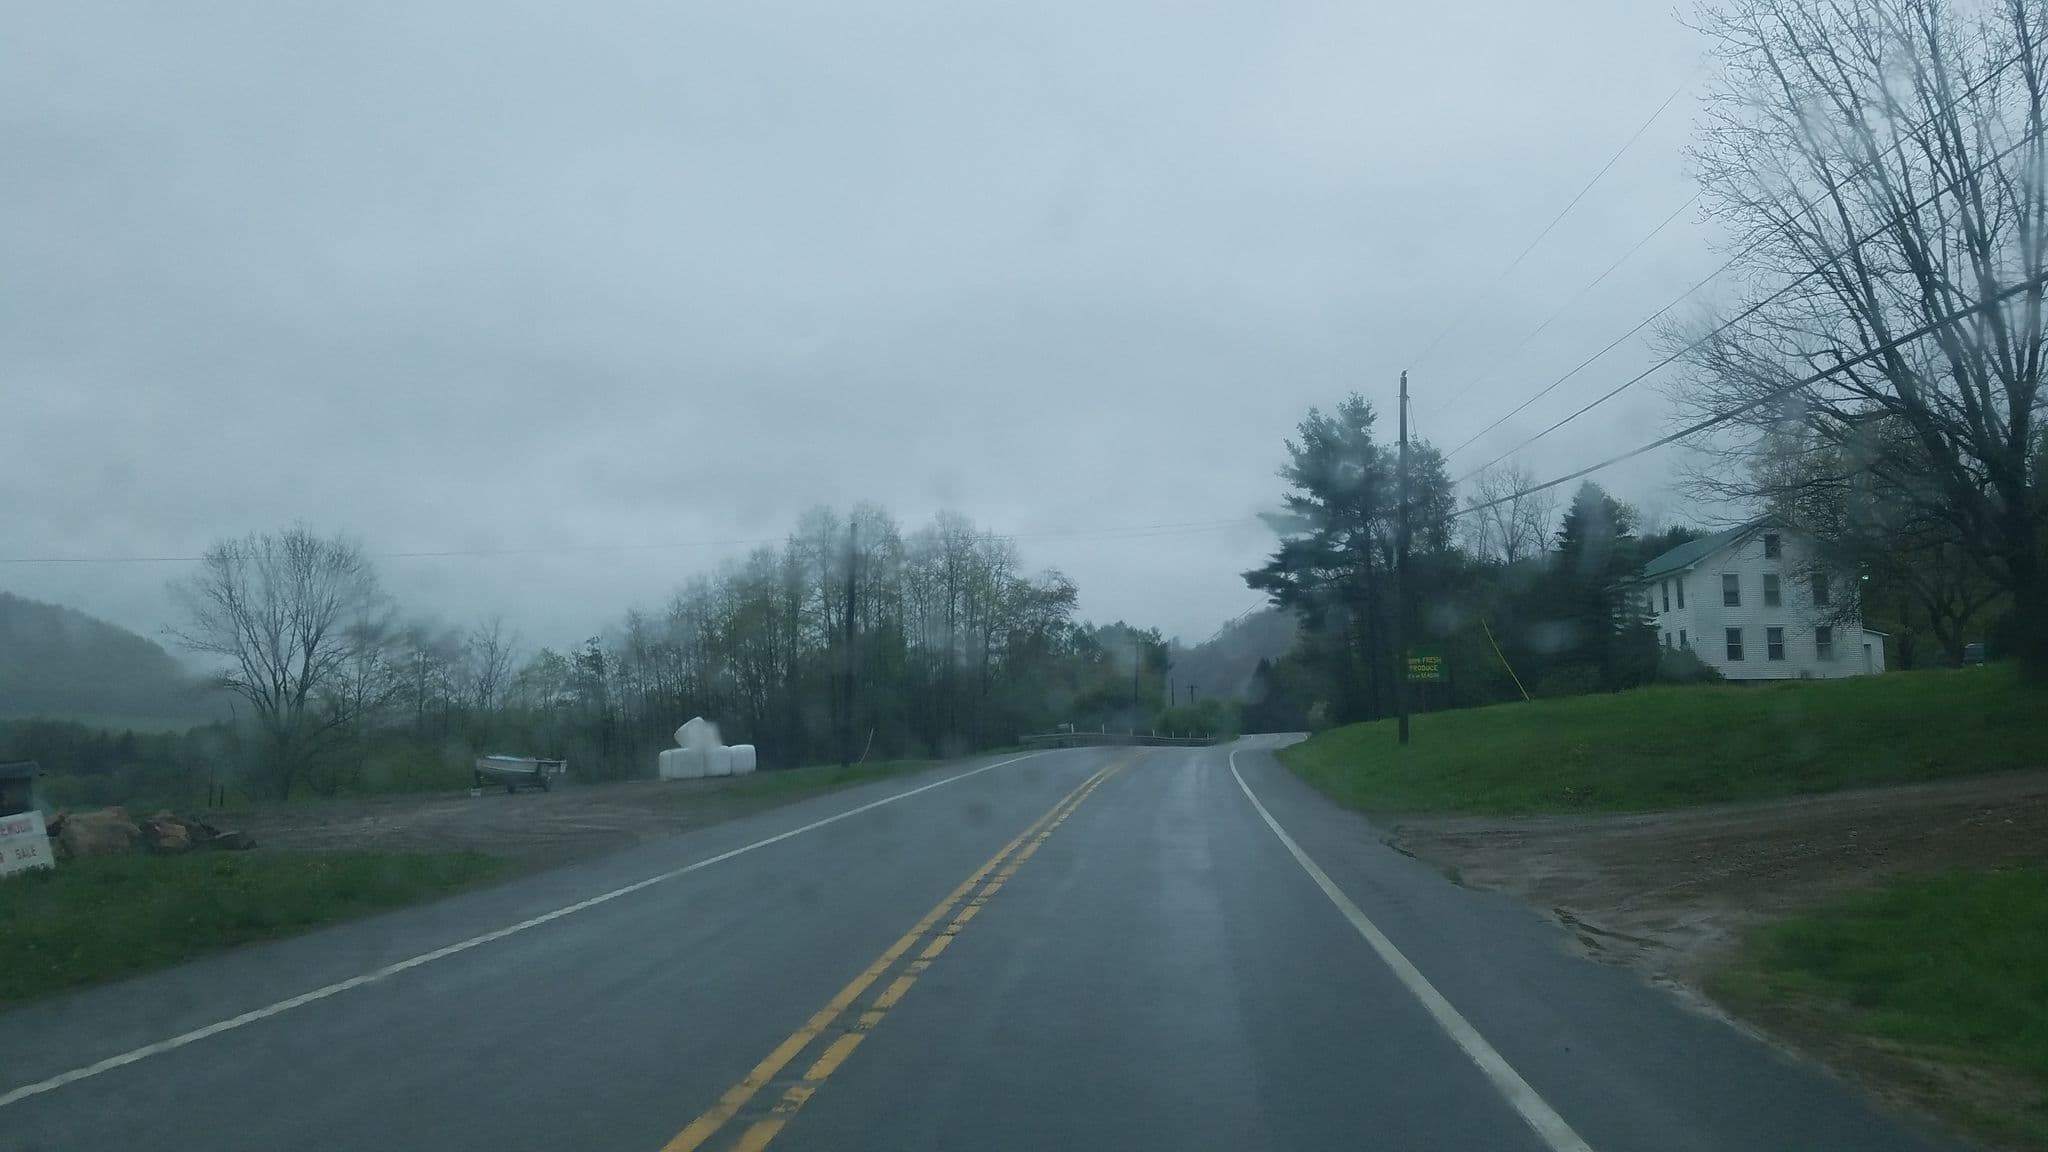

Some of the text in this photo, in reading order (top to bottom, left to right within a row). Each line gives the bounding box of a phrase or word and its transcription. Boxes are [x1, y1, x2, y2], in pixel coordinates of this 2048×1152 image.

[1422, 656, 1441, 664] FRESH
[1408, 664, 1440, 672] PRODUCE
[15, 846, 38, 859] SALE
